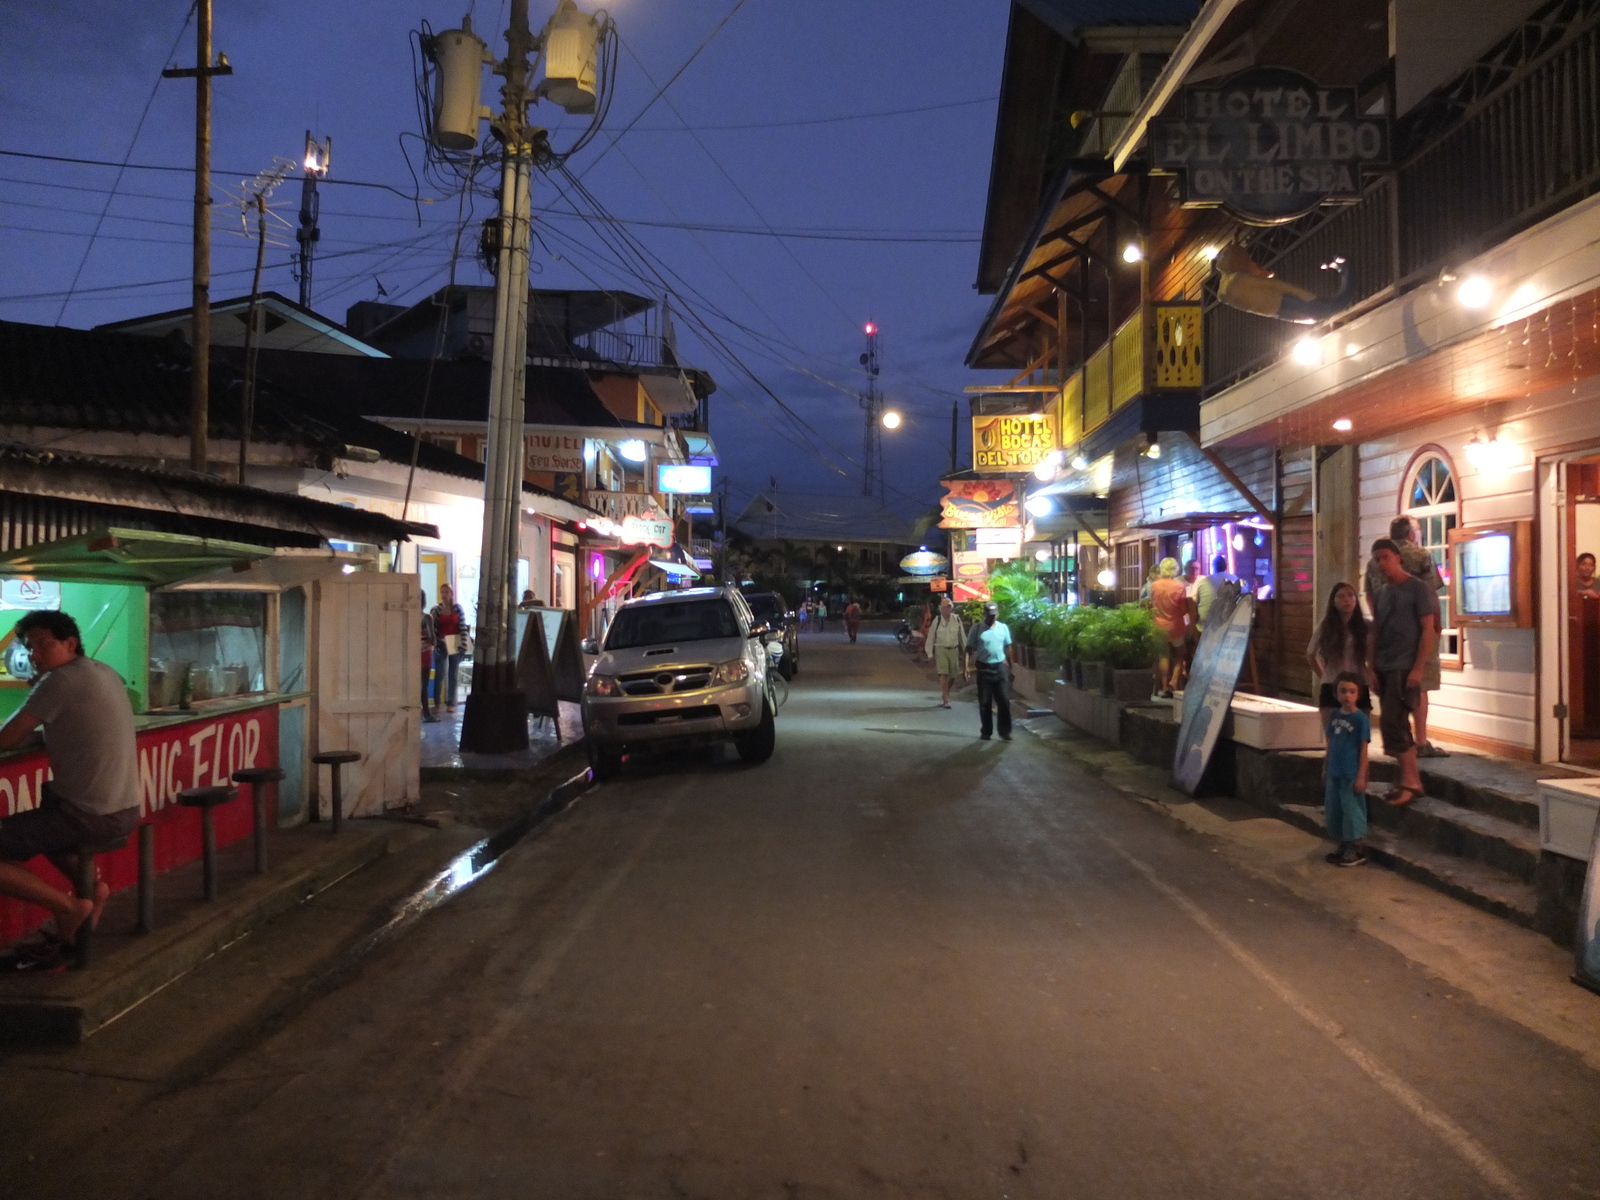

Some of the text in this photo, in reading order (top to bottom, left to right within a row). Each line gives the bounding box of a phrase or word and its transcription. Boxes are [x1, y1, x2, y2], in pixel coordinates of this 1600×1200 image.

[1194, 87, 1348, 120] HOTEL
[1164, 121, 1381, 164] EL LIMBO
[1194, 164, 1355, 195] ON THE SEA
[1000, 418, 1052, 435] HOTEL
[1001, 433, 1052, 450] BOCAS
[977, 450, 1008, 466] DEL
